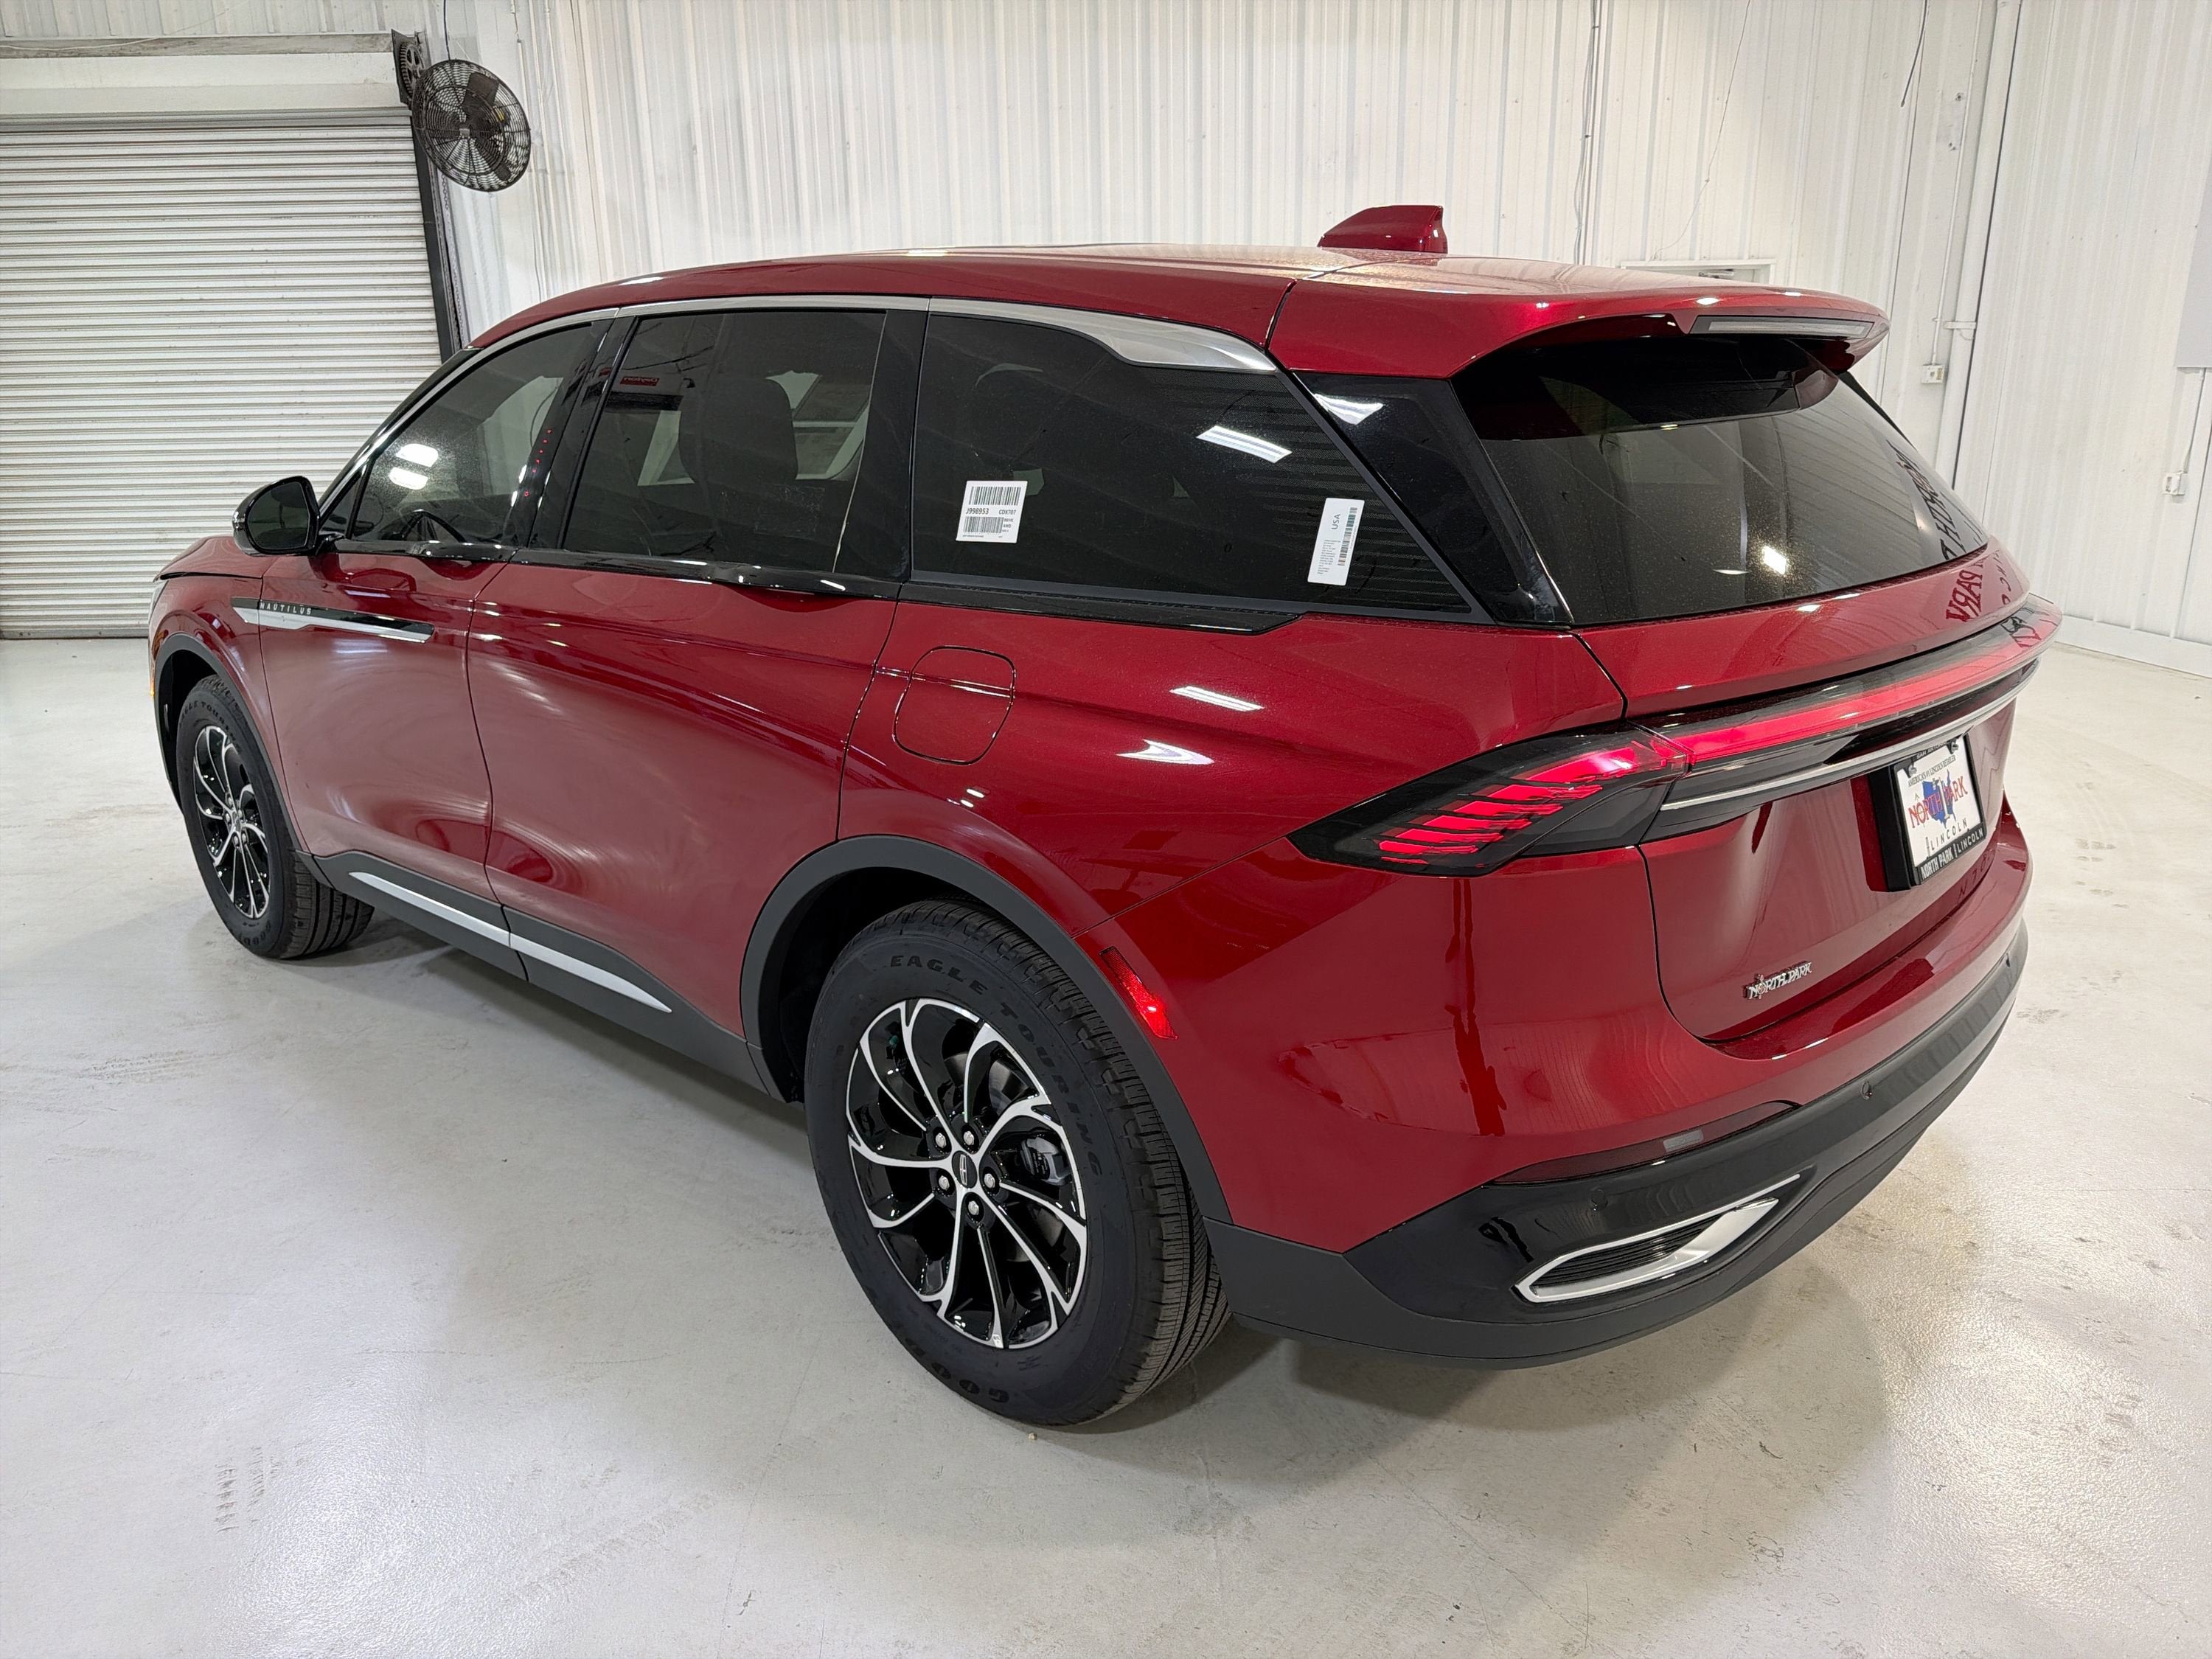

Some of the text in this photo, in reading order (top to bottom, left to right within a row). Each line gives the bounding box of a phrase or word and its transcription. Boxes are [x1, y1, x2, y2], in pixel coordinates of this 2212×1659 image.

[1331, 513, 1341, 530] USA
[260, 602, 312, 615] NAUTILUS
[1907, 775, 1968, 829] NORTH PARK
[1920, 856, 1939, 880] NORTH
[1938, 846, 1954, 868] PARK
[1956, 827, 1983, 853] LINCOLN
[1930, 817, 1967, 851] LINCOLN
[1748, 961, 1812, 1000] NORTH PARK
[889, 955, 1102, 1176] EAGLE TOURING
